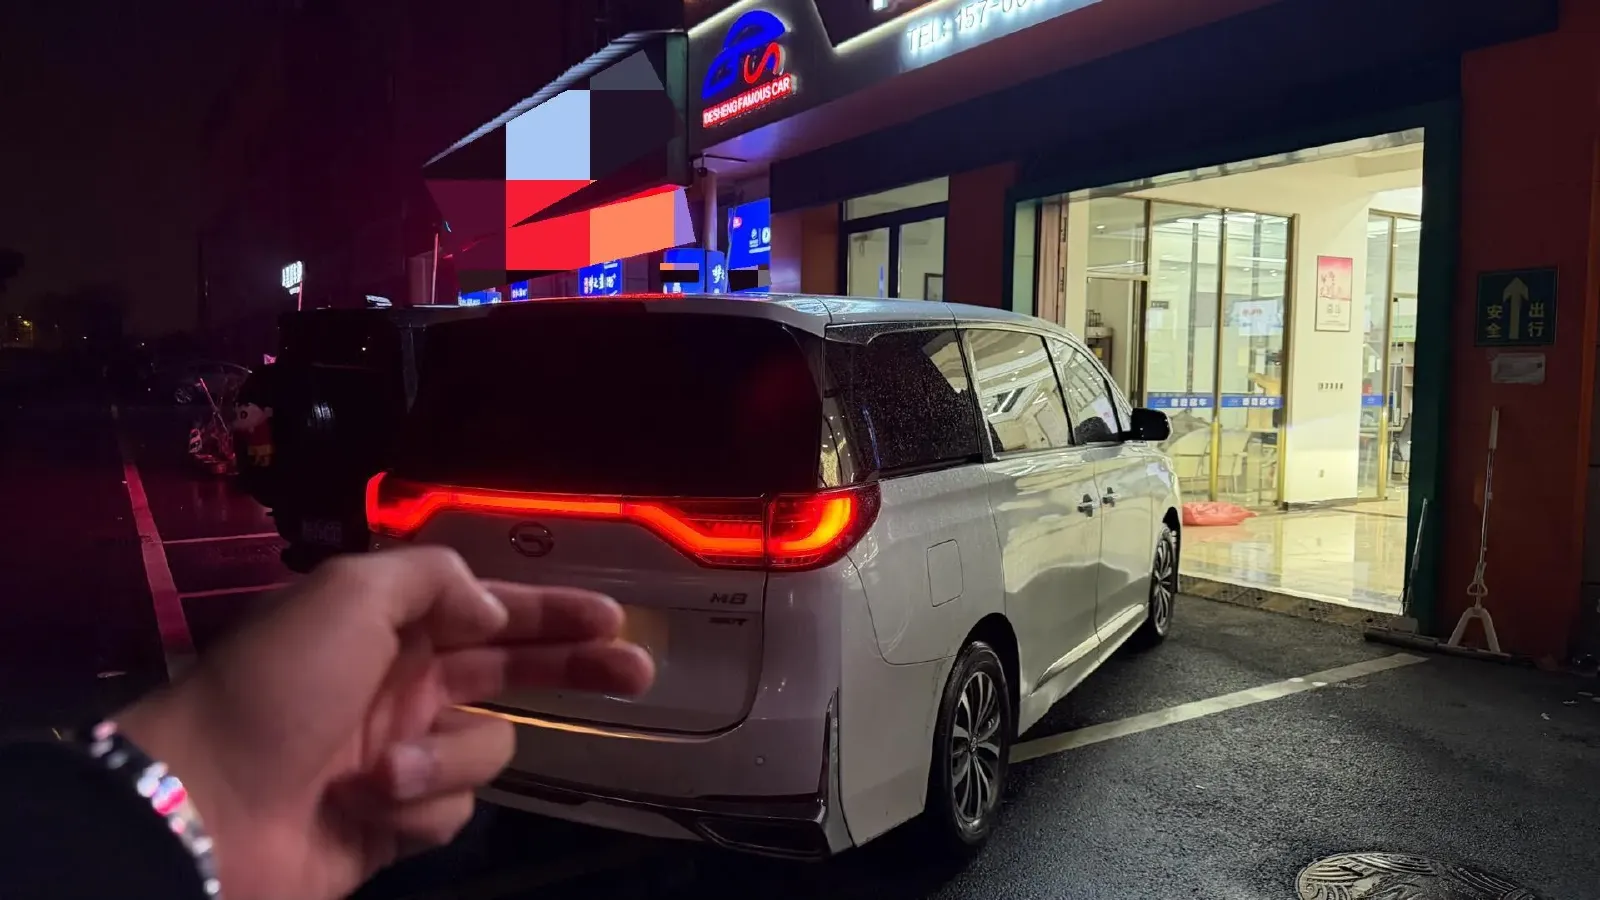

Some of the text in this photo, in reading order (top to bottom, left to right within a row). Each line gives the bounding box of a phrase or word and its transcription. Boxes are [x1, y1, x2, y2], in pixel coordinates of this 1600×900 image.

[703, 76, 791, 125] DESHENG FAMOUS CAR
[1486, 304, 1504, 339] 安全
[1527, 302, 1546, 338] 出行
[709, 591, 749, 605] M8
